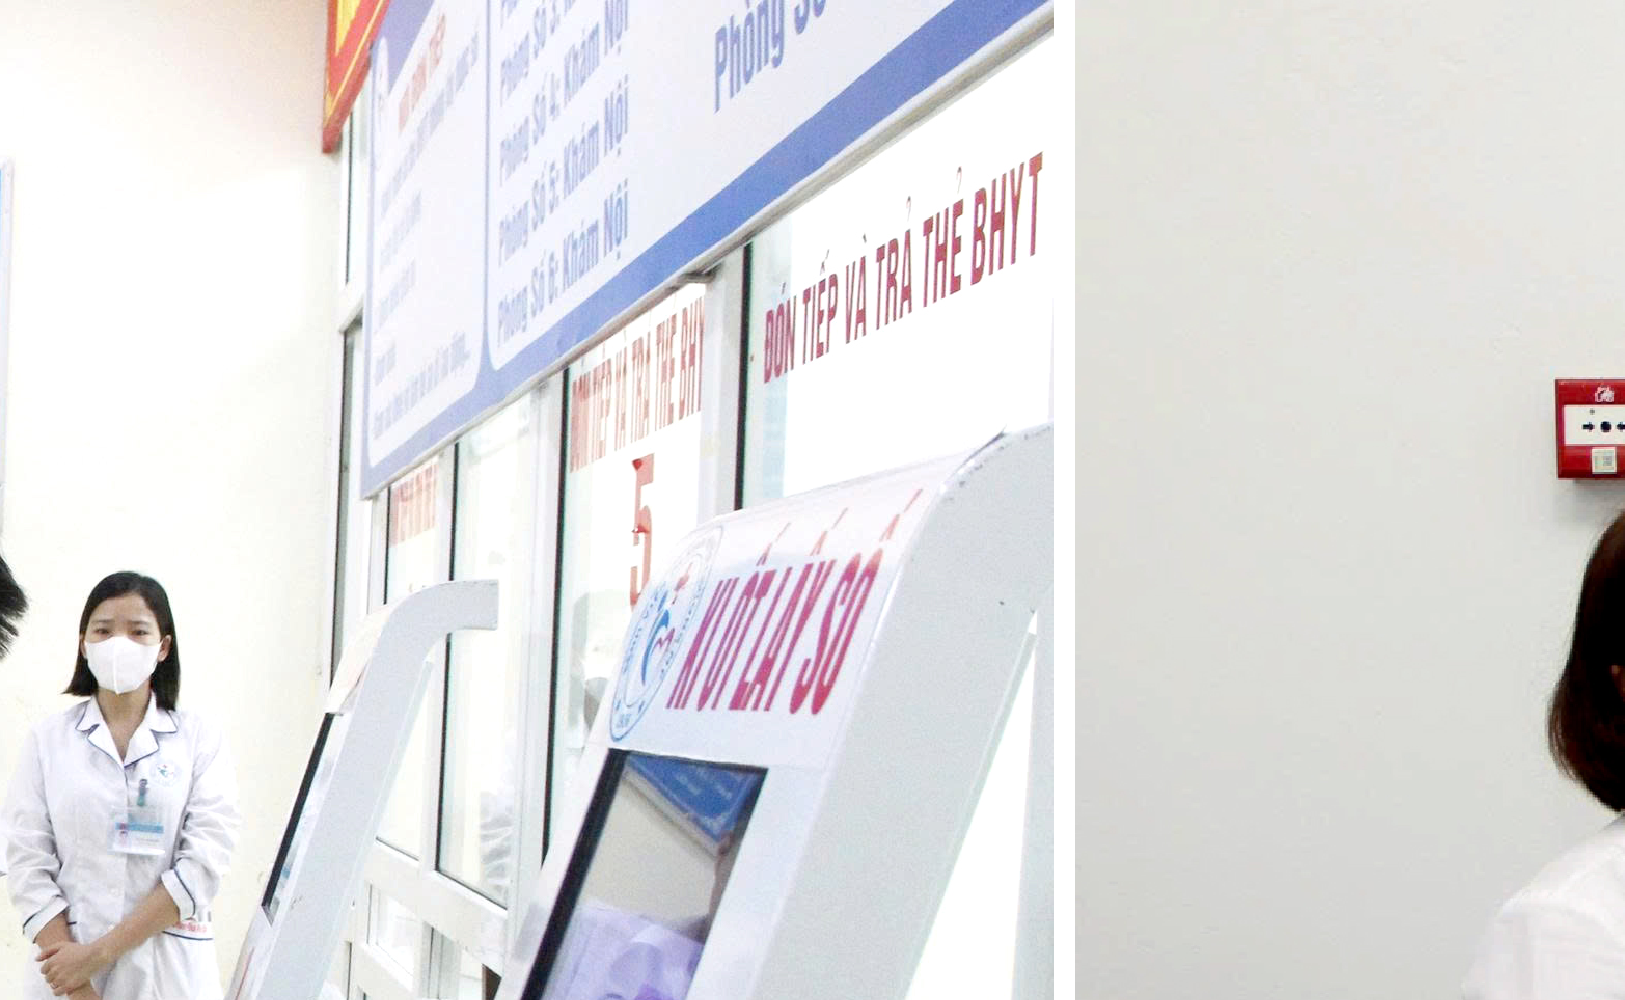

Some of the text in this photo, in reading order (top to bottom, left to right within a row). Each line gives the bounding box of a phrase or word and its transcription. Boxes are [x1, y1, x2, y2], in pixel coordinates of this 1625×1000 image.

[564, 119, 599, 201] Khám
[604, 73, 628, 158] Nội
[563, 218, 600, 295] Khám
[604, 177, 628, 262] Nội
[763, 151, 1043, 384] ĐÓN TIẾP VÀ TRẢ THẺ BHYT
[629, 452, 656, 613] 5
